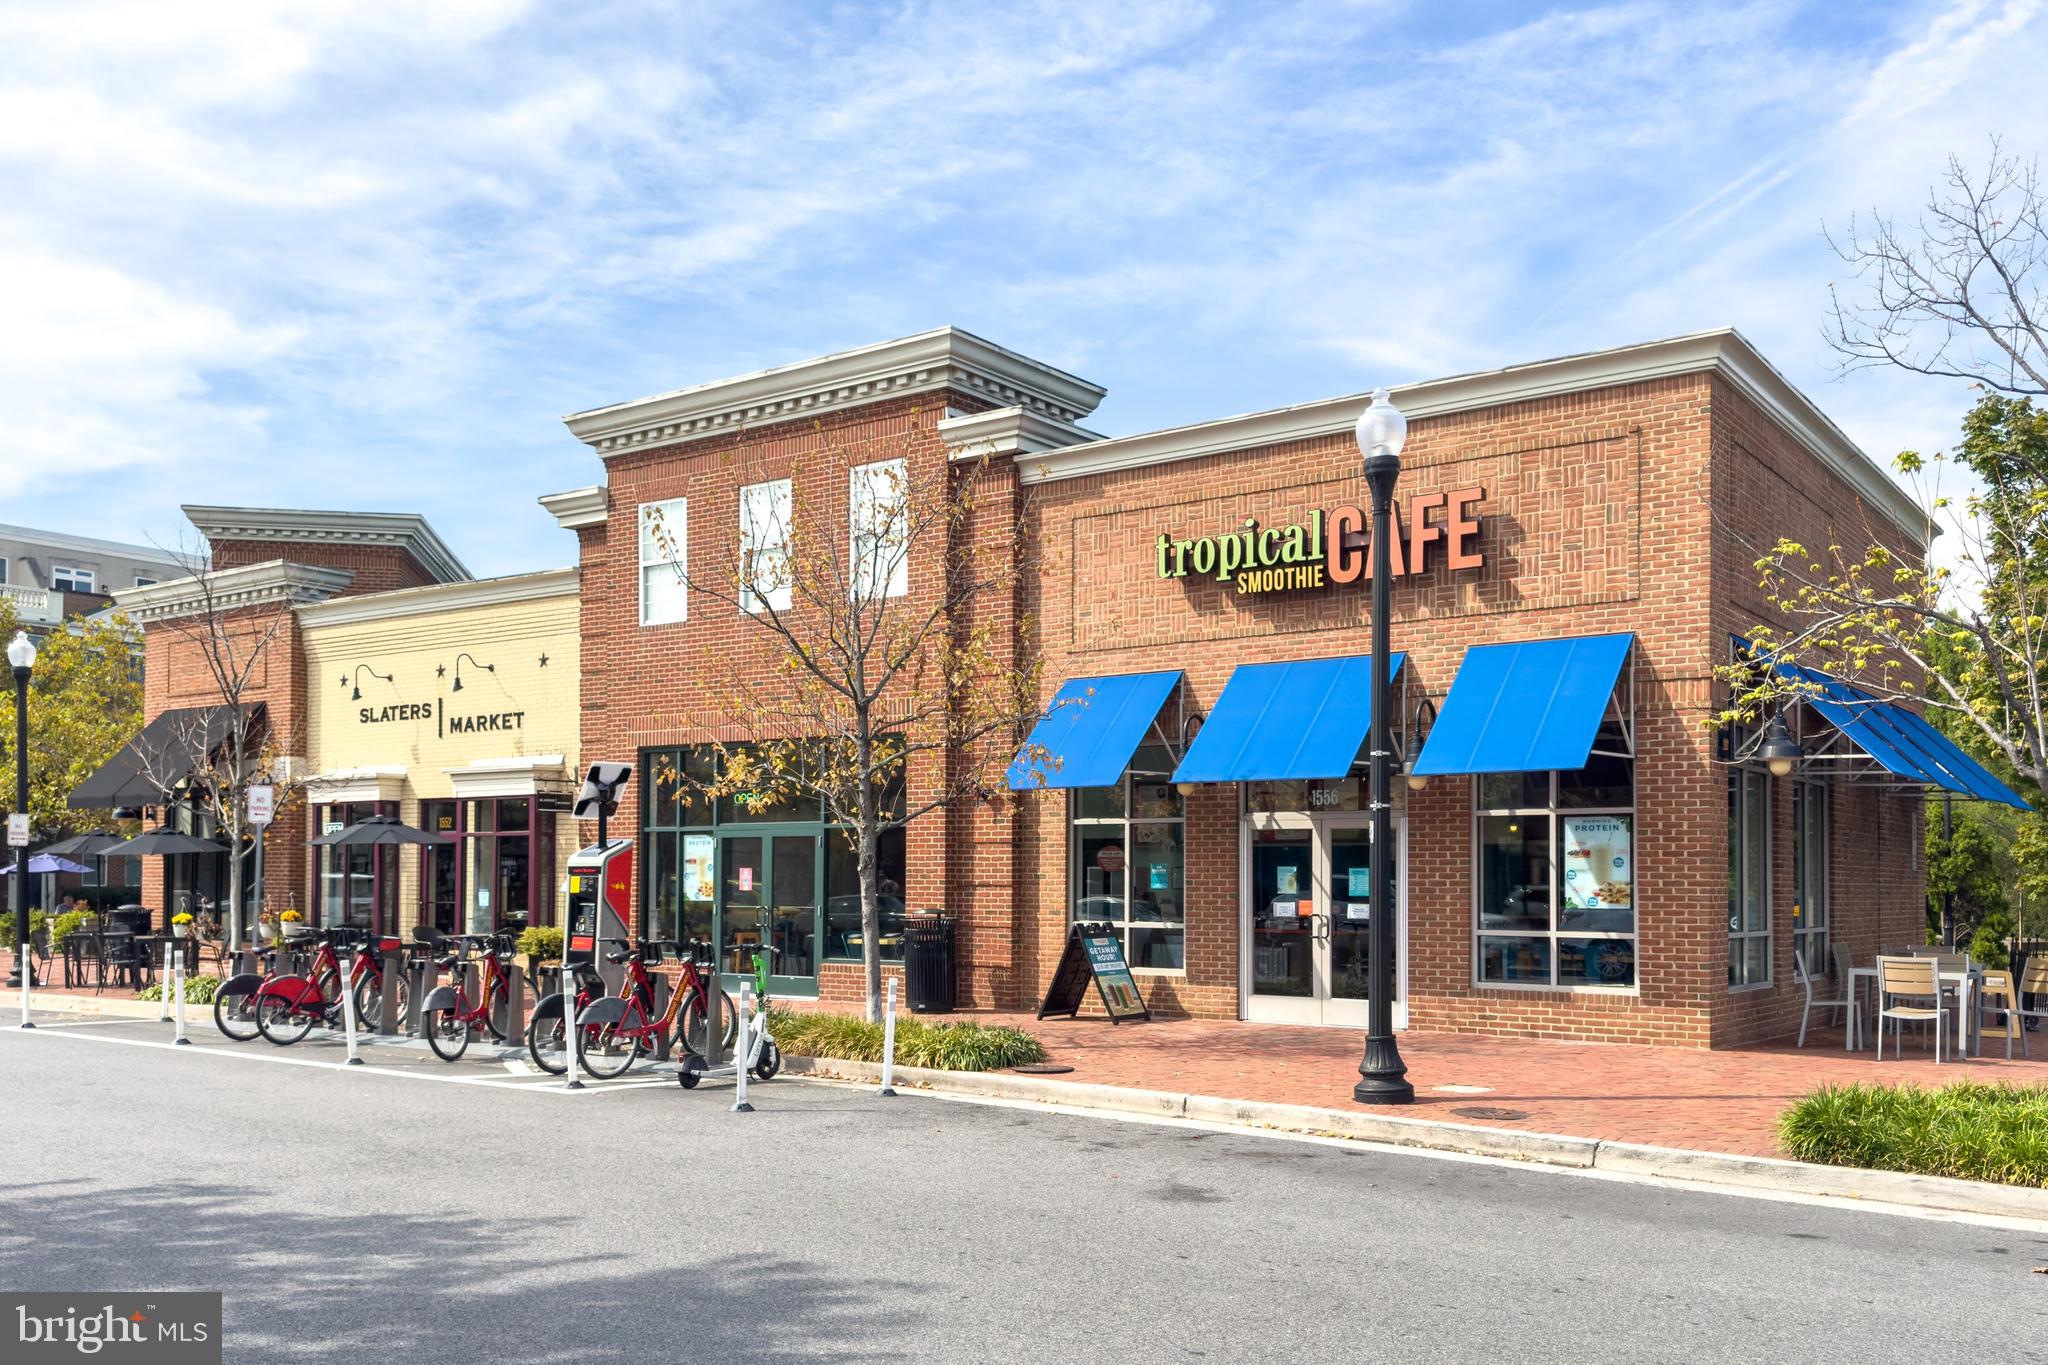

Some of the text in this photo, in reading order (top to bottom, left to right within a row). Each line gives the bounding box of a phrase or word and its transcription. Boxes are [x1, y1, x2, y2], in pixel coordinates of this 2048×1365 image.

[1156, 509, 1324, 581] tropical
[1328, 487, 1485, 583] CAFE
[1237, 565, 1324, 594] SMOOTHIE
[359, 703, 525, 733] SLATERS MARKET
[1312, 790, 1338, 805] 1556
[439, 817, 452, 828] 1552
[1575, 824, 1620, 832] PROTEIN
[1089, 946, 1118, 954] GETAWAY
